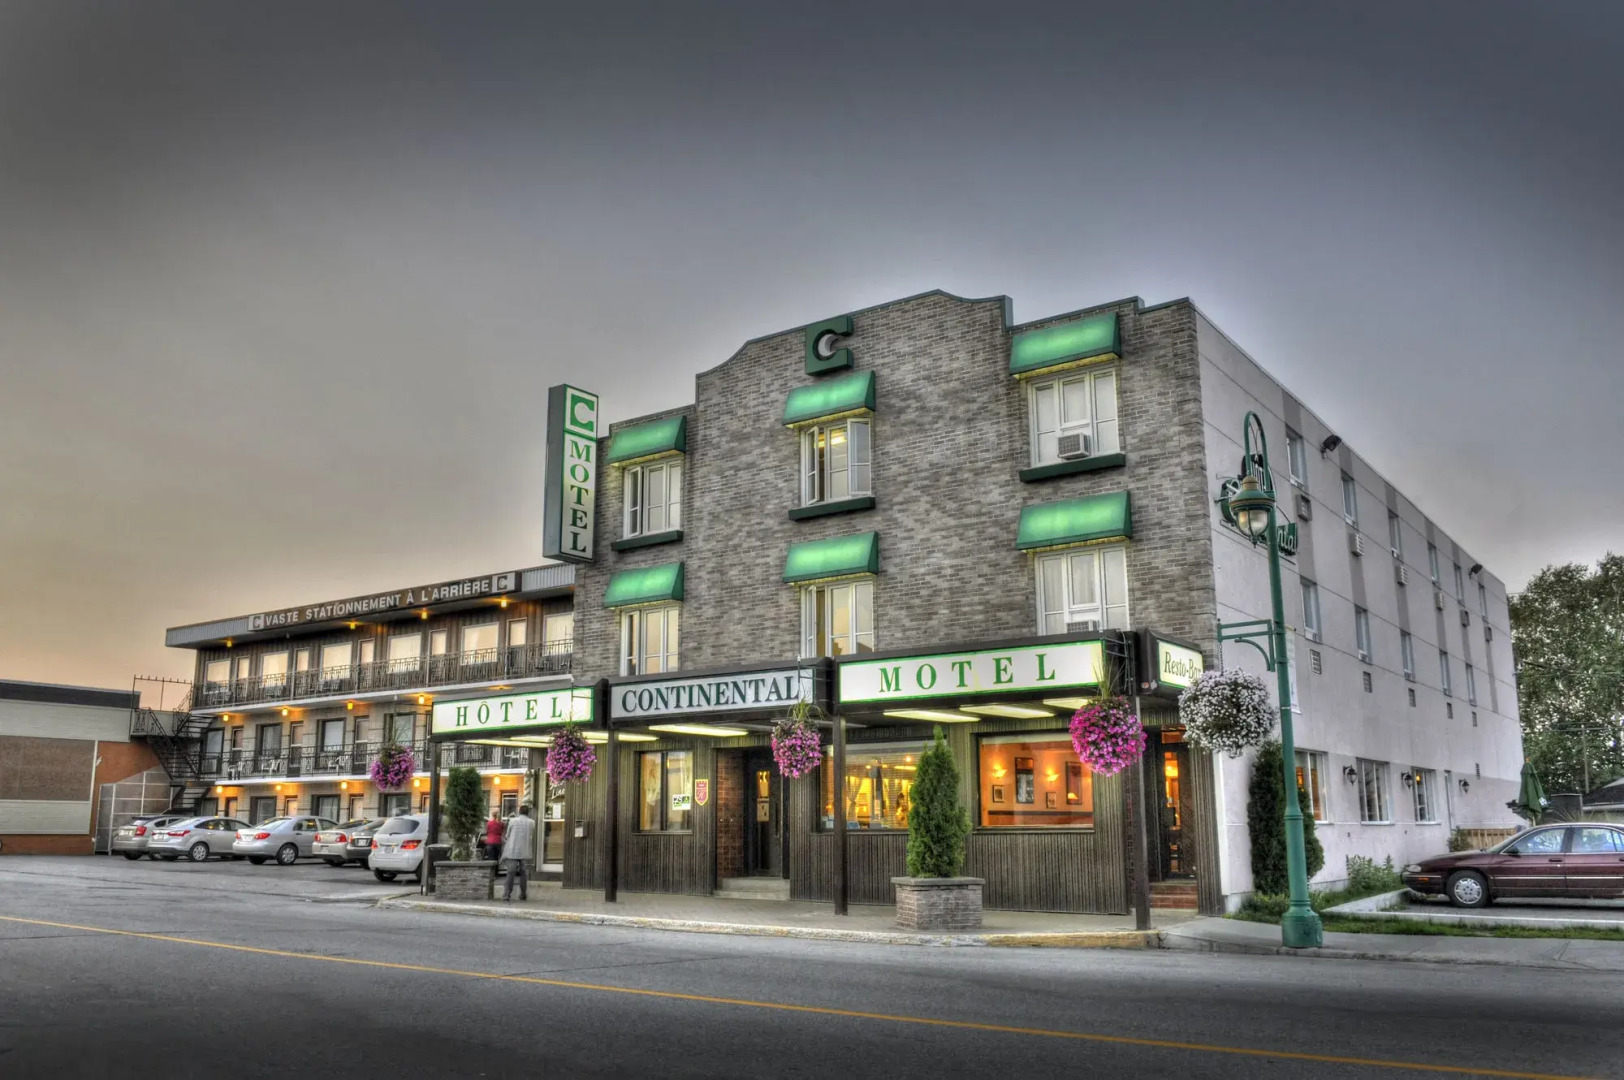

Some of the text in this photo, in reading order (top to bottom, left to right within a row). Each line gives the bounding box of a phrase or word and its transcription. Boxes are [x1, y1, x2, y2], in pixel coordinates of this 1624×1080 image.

[569, 439, 593, 553] MOTEL
[265, 611, 299, 626] VASTE
[306, 594, 402, 620] STATIONNEMENT
[406, 589, 414, 603] À
[879, 653, 1056, 693] MOTEL
[455, 696, 563, 727] HÔTEL
[622, 675, 800, 713] CONTINENTAL
